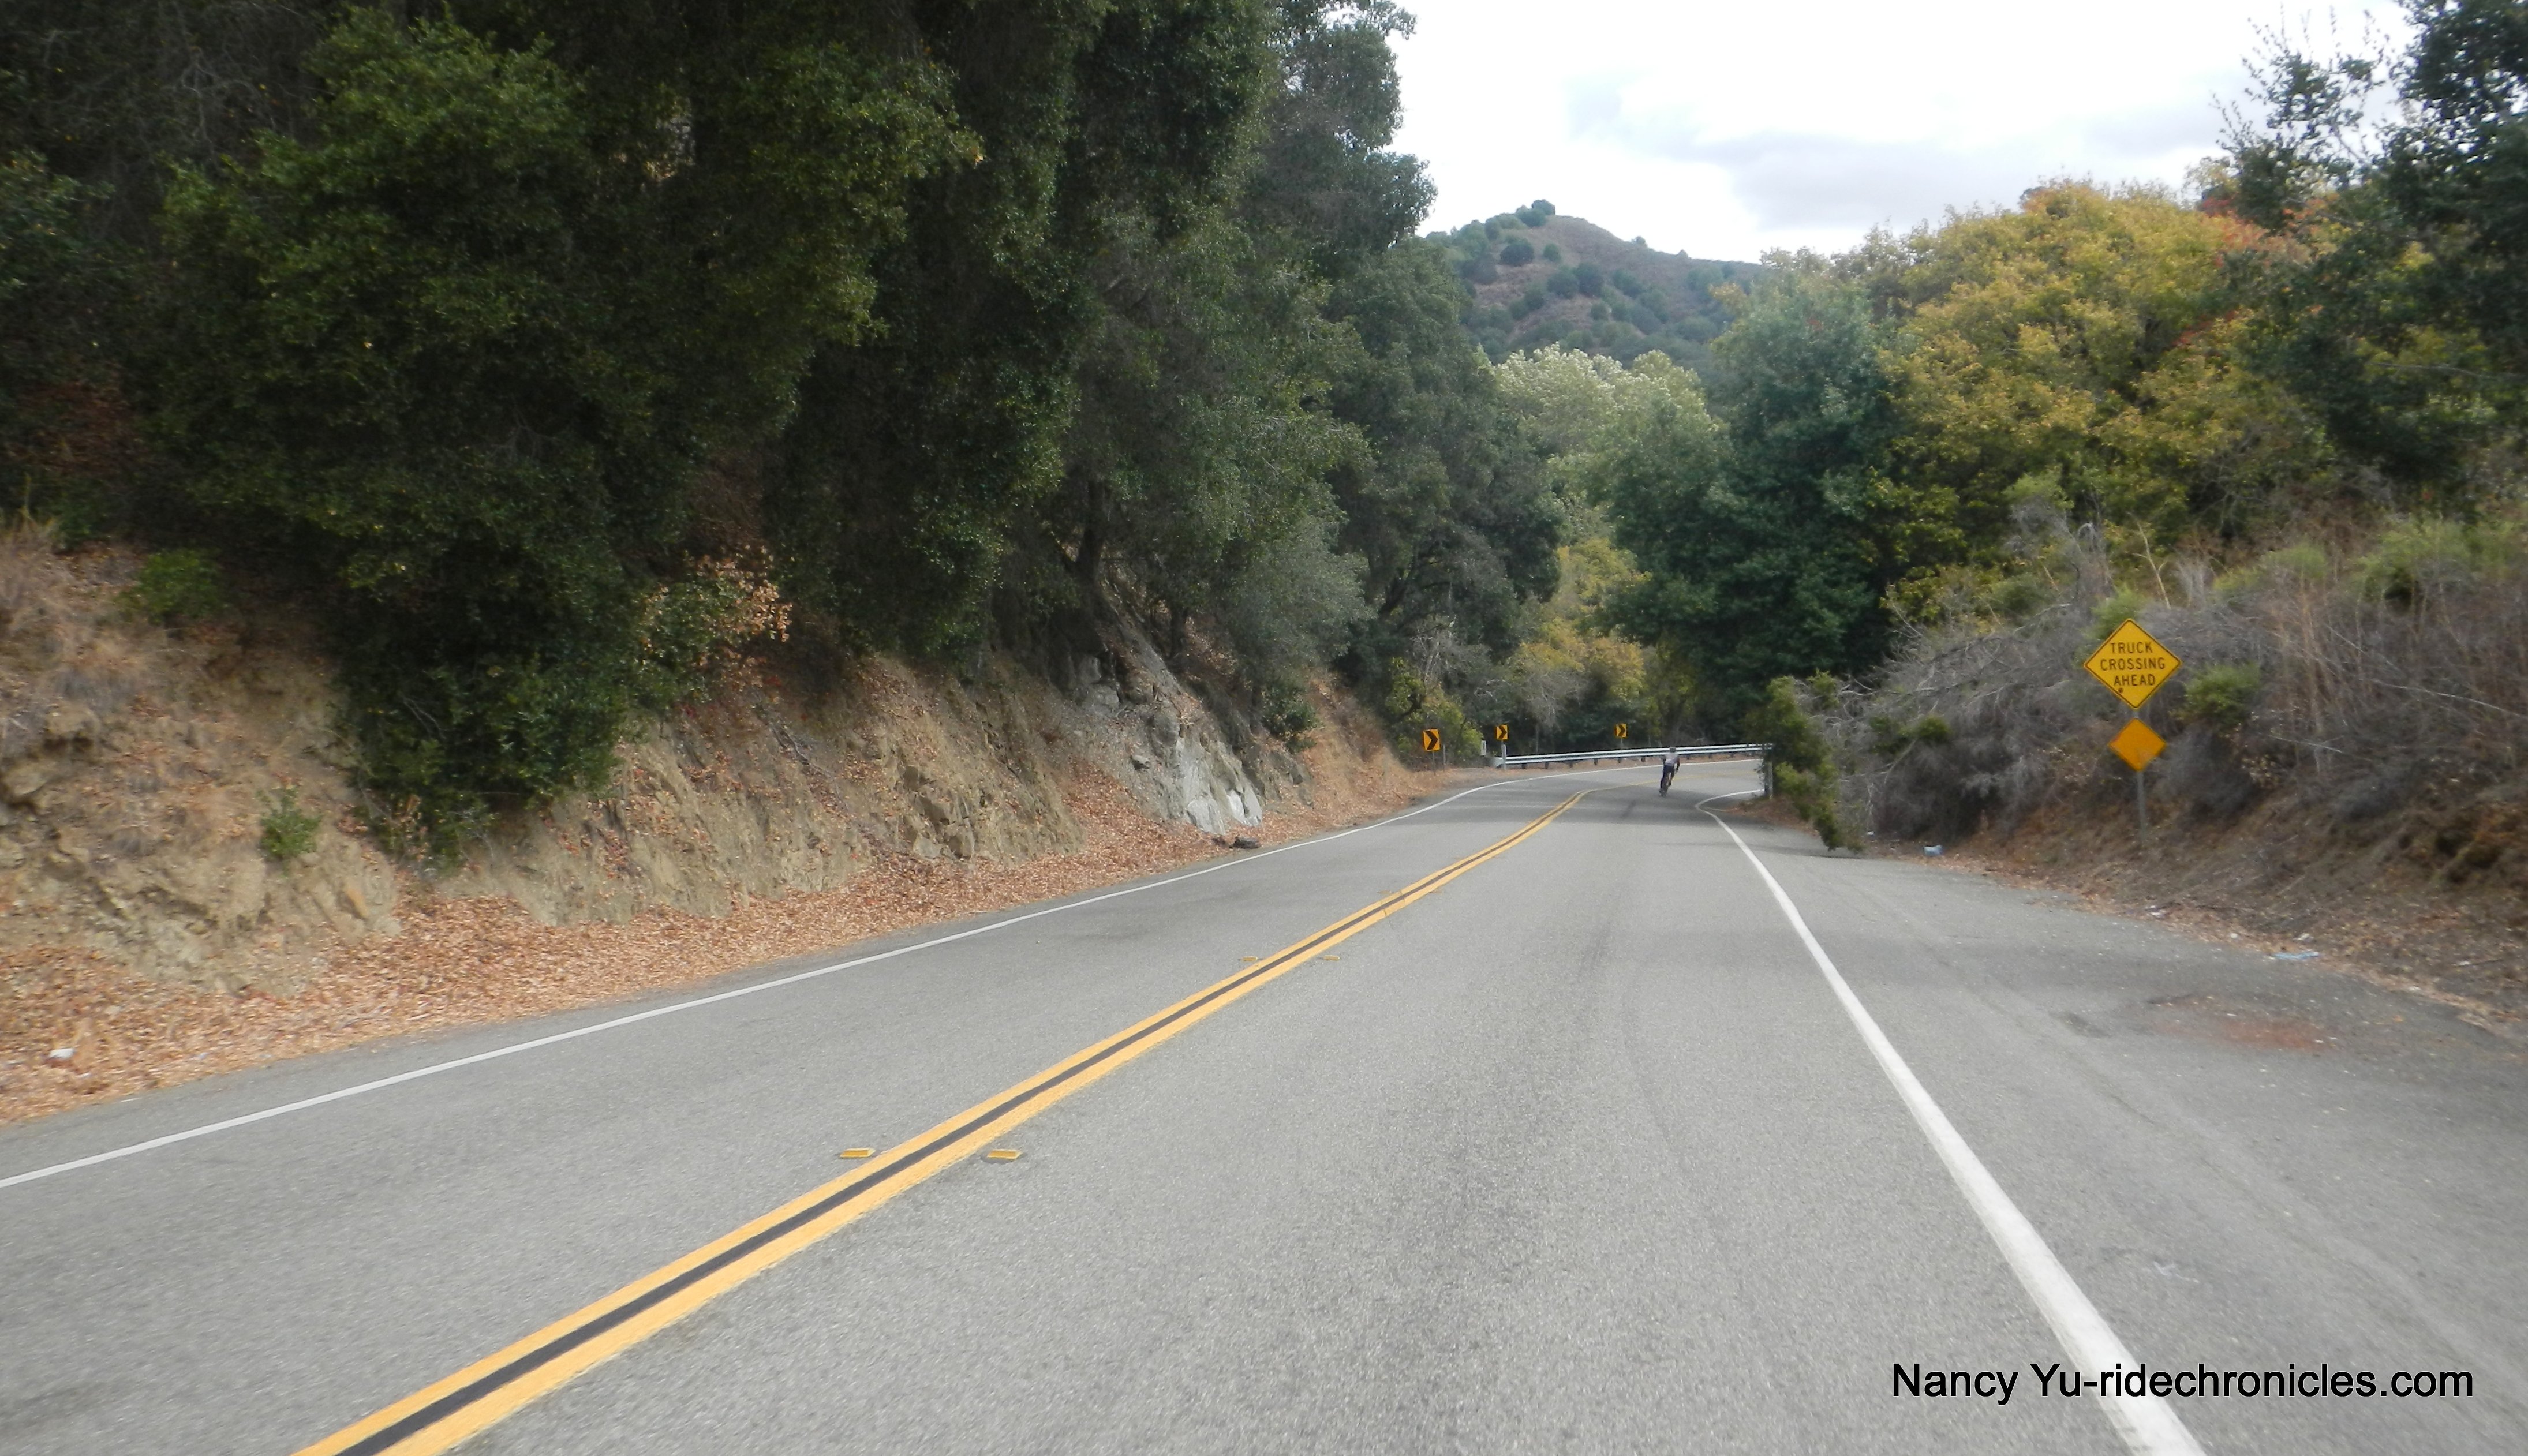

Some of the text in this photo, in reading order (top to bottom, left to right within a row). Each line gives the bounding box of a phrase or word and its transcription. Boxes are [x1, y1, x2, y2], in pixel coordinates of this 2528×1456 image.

[2110, 642, 2153, 653] TRUCK
[2100, 657, 2166, 671] CROSSING
[2114, 674, 2156, 686] AHEAD
